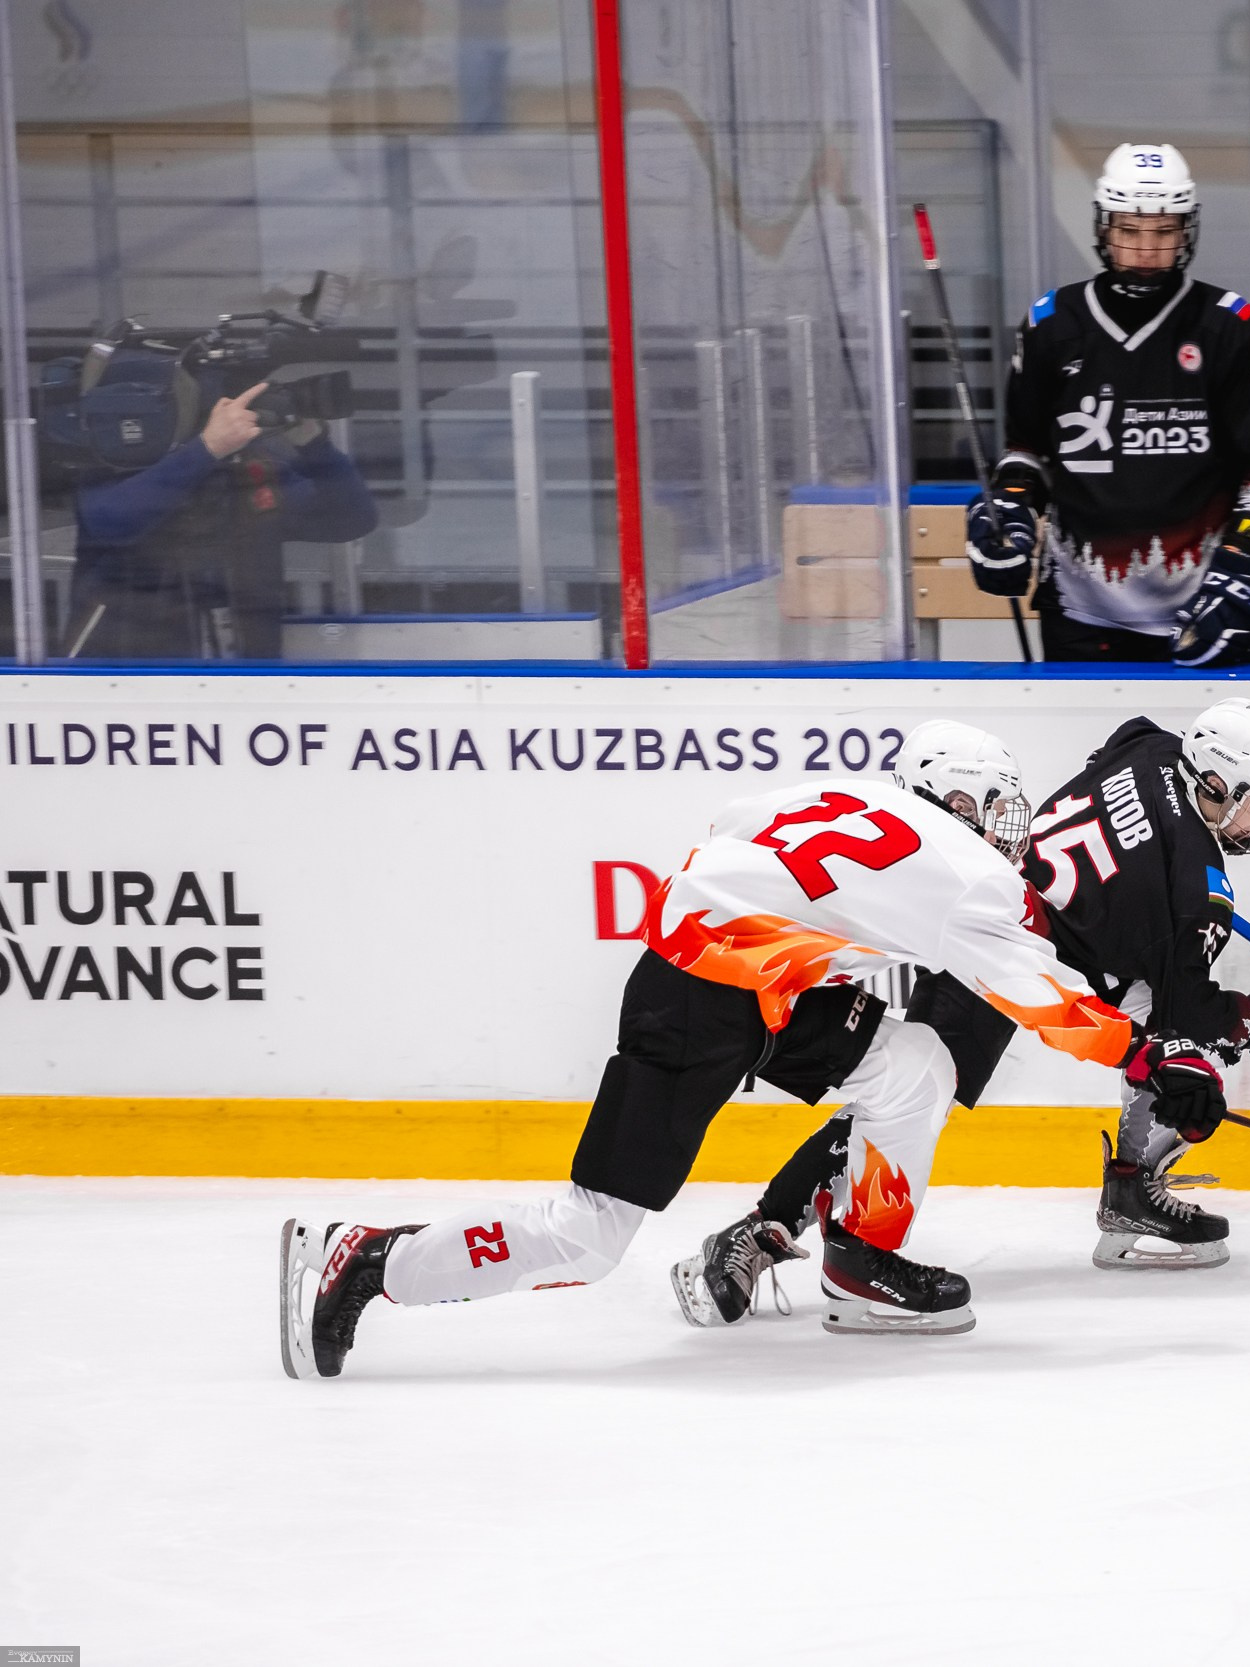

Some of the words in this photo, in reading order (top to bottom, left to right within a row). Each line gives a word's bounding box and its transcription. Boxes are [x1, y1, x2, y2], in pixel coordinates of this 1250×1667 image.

[1122, 407, 1166, 424] Дети
[1167, 407, 1208, 421] Азии
[1121, 426, 1211, 455] 2023
[8, 722, 222, 766] ILDREN
[249, 722, 328, 767] OF
[351, 727, 486, 772] ASIA
[510, 728, 779, 772] KUZBASS
[750, 791, 922, 903] 22
[0, 937, 265, 1001] VANCE
[464, 1221, 510, 1269] 22
[869, 1280, 907, 1303] CCM
